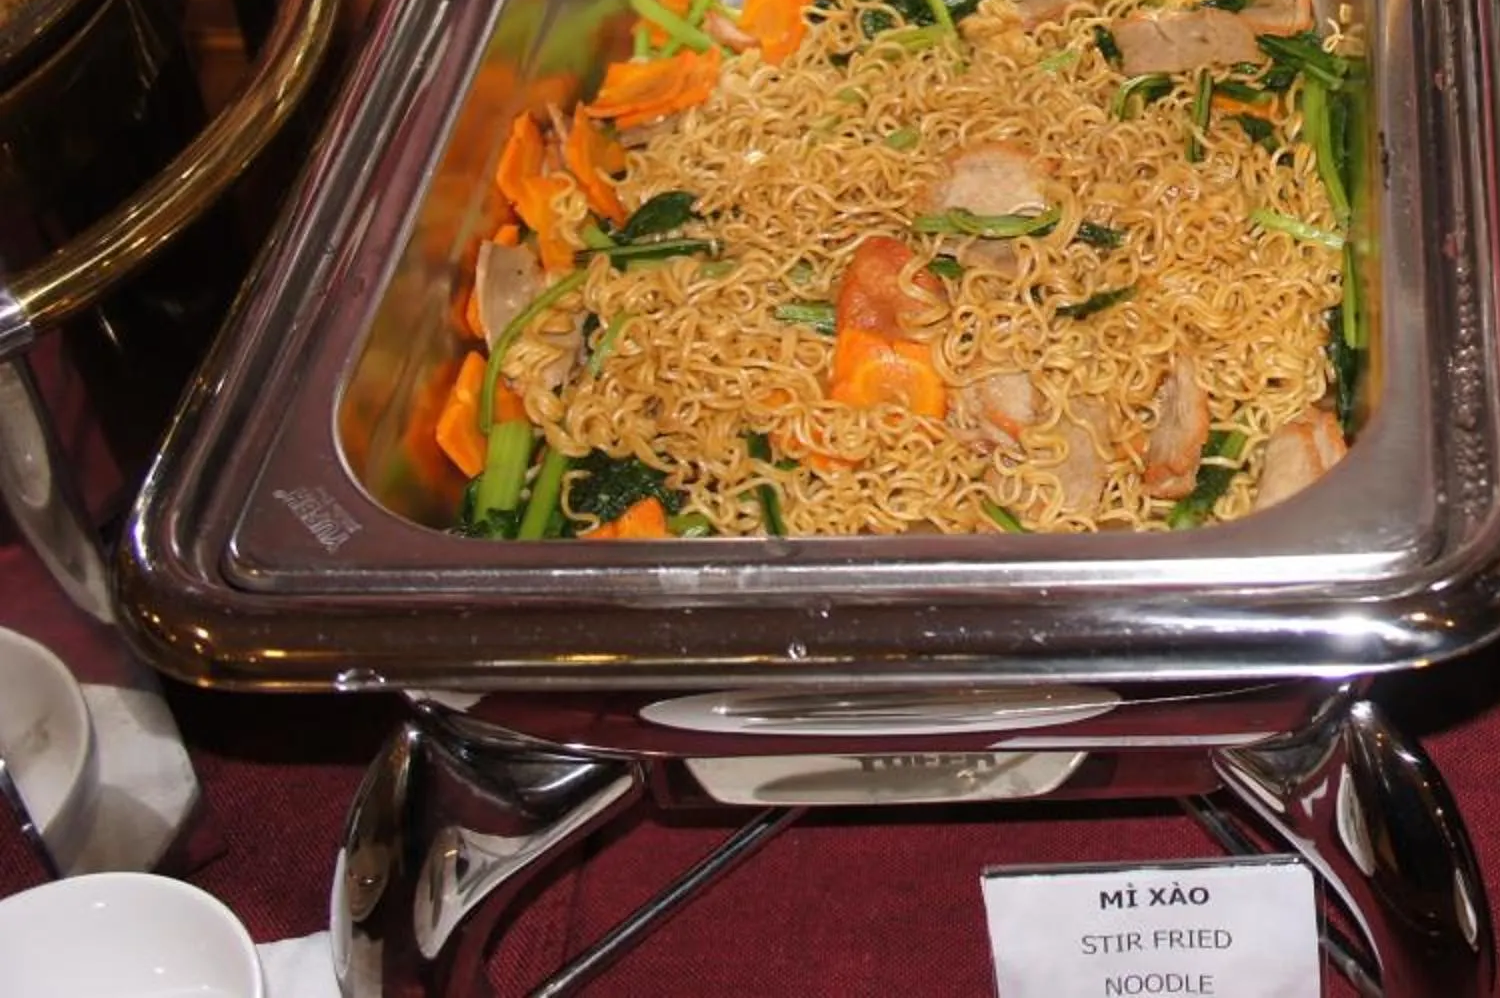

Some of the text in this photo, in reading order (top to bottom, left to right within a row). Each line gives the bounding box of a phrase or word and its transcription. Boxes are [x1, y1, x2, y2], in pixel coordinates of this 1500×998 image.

[1099, 881, 1210, 910] MÌ XÀO
[1081, 928, 1233, 955] STIR FRIED
[1105, 972, 1215, 997] NOODLE
